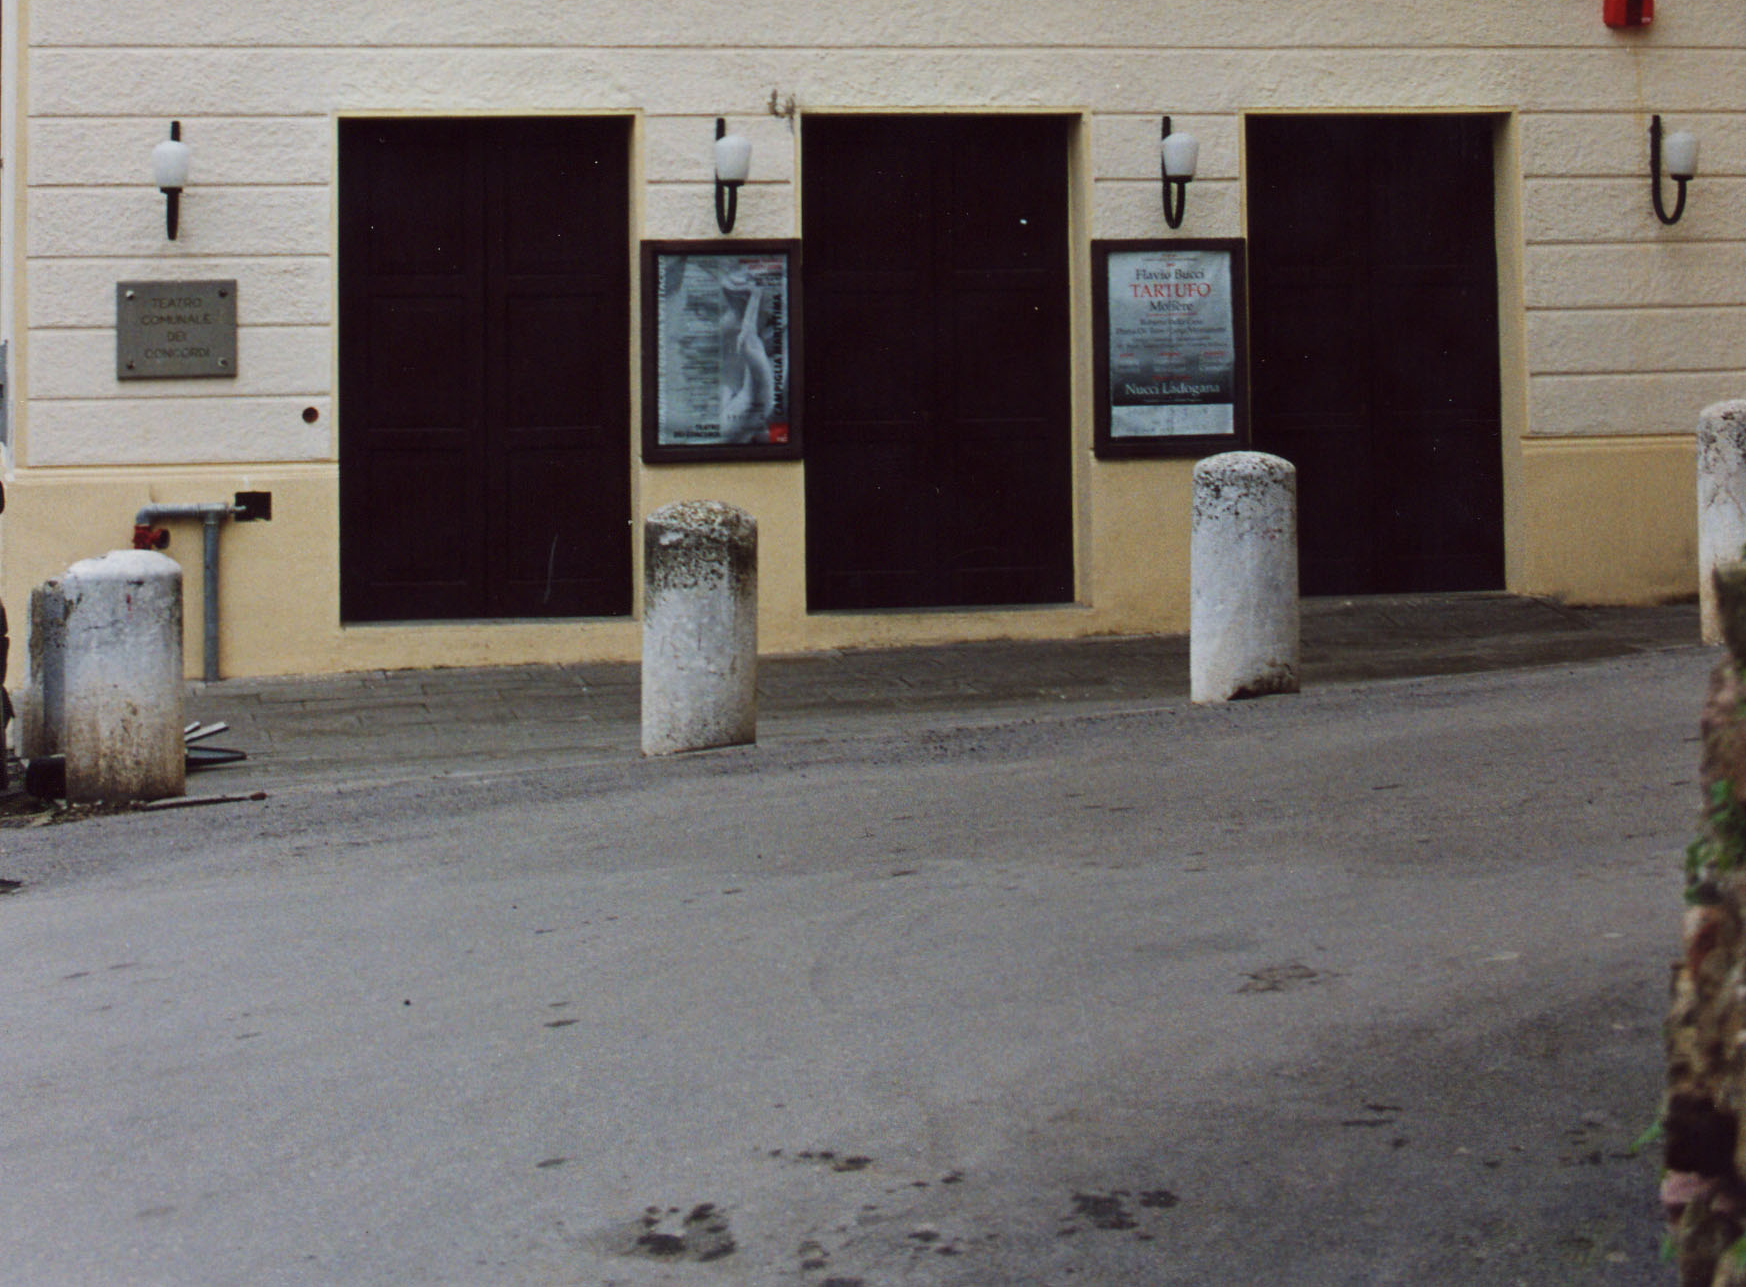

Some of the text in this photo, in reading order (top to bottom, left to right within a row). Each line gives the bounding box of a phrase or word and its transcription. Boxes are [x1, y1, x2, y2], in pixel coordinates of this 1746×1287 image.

[1136, 268, 1205, 280] Flavio Bucci
[1128, 282, 1212, 298] TARTUFO
[151, 297, 203, 309] TEATRO
[141, 313, 212, 325] COMUNALE
[167, 331, 187, 342] DEI
[144, 347, 210, 359] CONCORDI
[774, 294, 784, 416] CAMPIGLIA MARITTIMA
[1125, 381, 1222, 397] Nucci Ladogana
